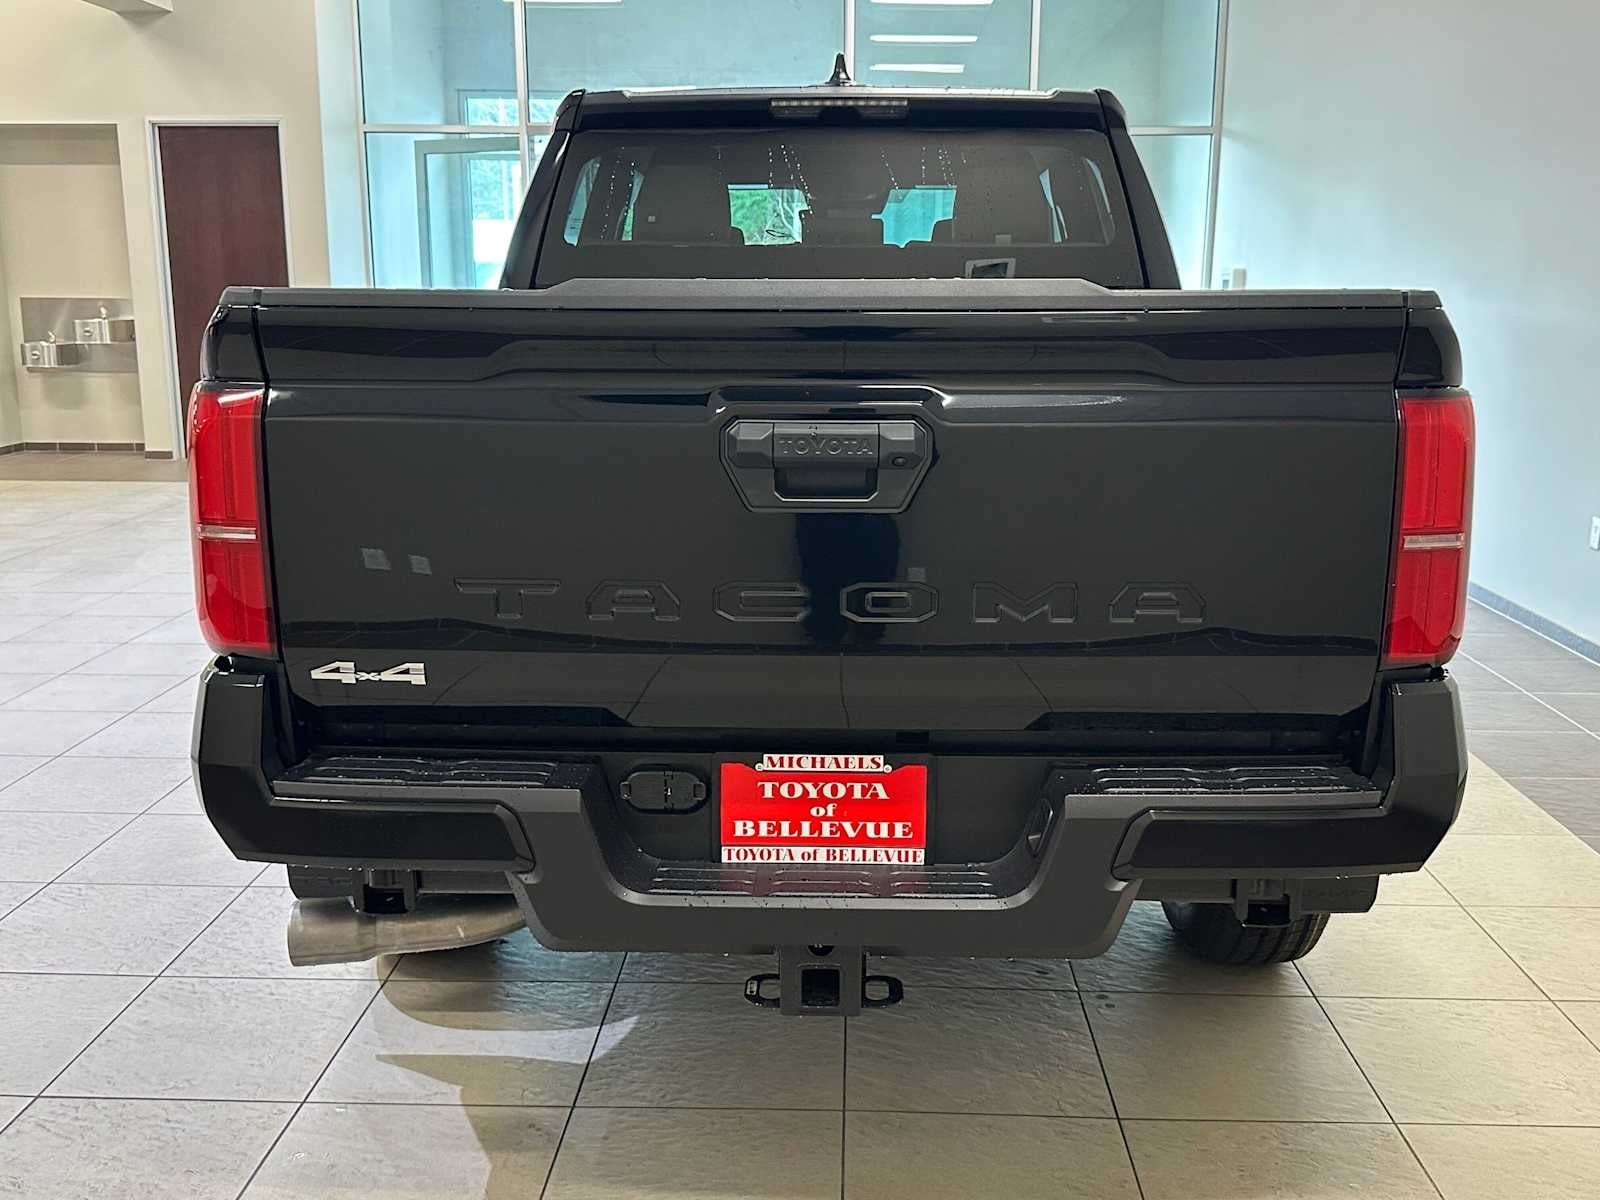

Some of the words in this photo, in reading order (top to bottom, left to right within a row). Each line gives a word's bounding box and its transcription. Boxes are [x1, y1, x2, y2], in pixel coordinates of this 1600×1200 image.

[778, 438, 873, 455] TOYOTA
[453, 577, 1205, 623] TACOMA
[310, 661, 426, 685] 4x4
[766, 755, 882, 770] MICHAELS
[757, 781, 890, 800] TOYOTA
[809, 803, 837, 817] of
[733, 820, 914, 839] BELLEVUE
[723, 848, 795, 861] TOYOTA
[801, 848, 819, 862] of
[825, 849, 923, 864] BELLEVUE
